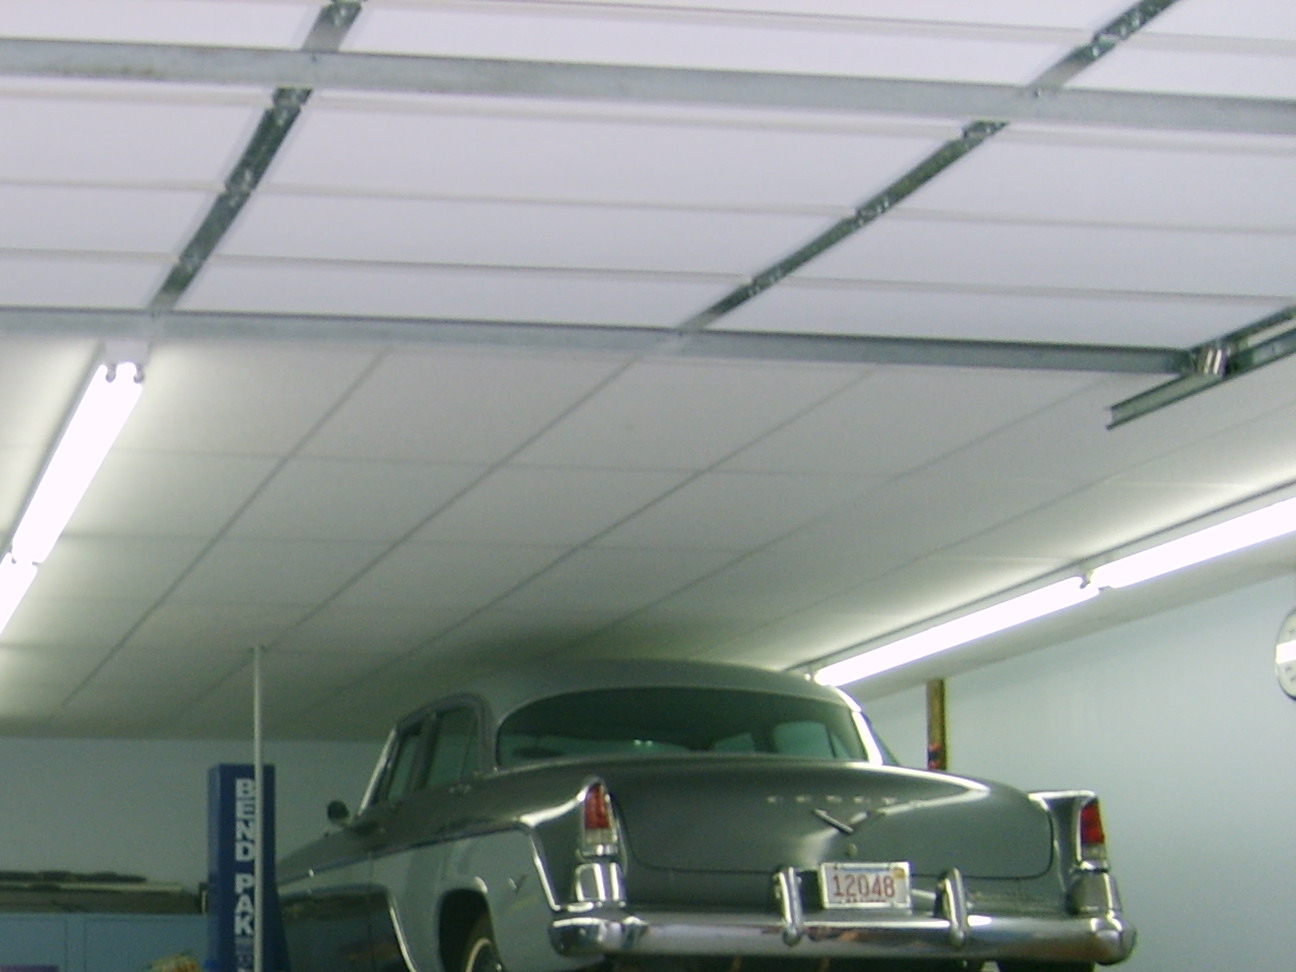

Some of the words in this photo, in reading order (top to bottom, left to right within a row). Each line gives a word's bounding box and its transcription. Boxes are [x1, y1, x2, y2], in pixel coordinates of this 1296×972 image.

[235, 778, 255, 862] BEND
[234, 873, 255, 936] PAK
[832, 874, 895, 898] 12048
